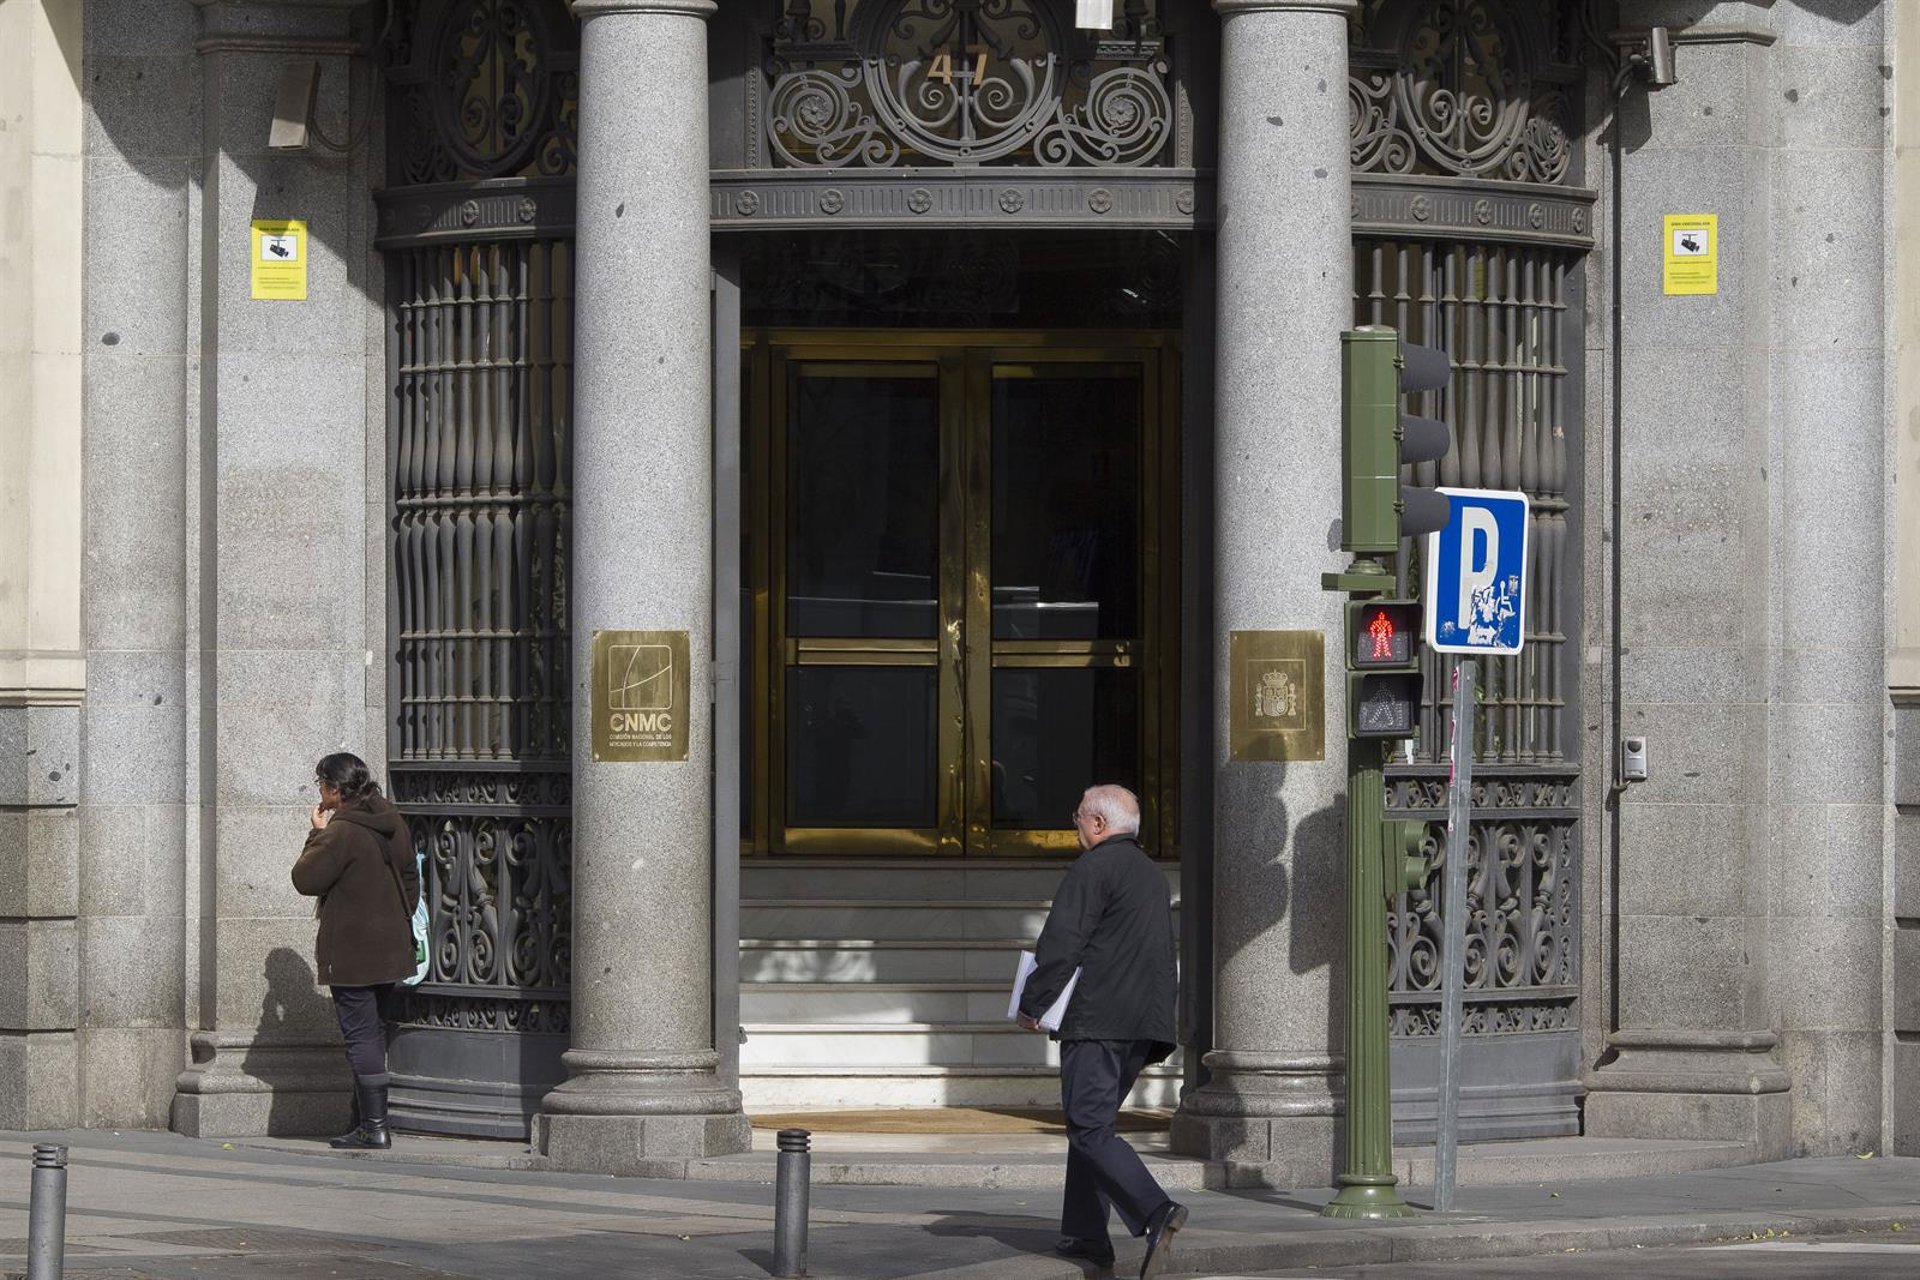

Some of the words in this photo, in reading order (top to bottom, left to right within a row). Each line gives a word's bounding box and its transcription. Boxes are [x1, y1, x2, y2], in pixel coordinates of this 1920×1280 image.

[927, 45, 989, 86] 47
[1458, 506, 1499, 630] P
[610, 713, 672, 732] CNMC
